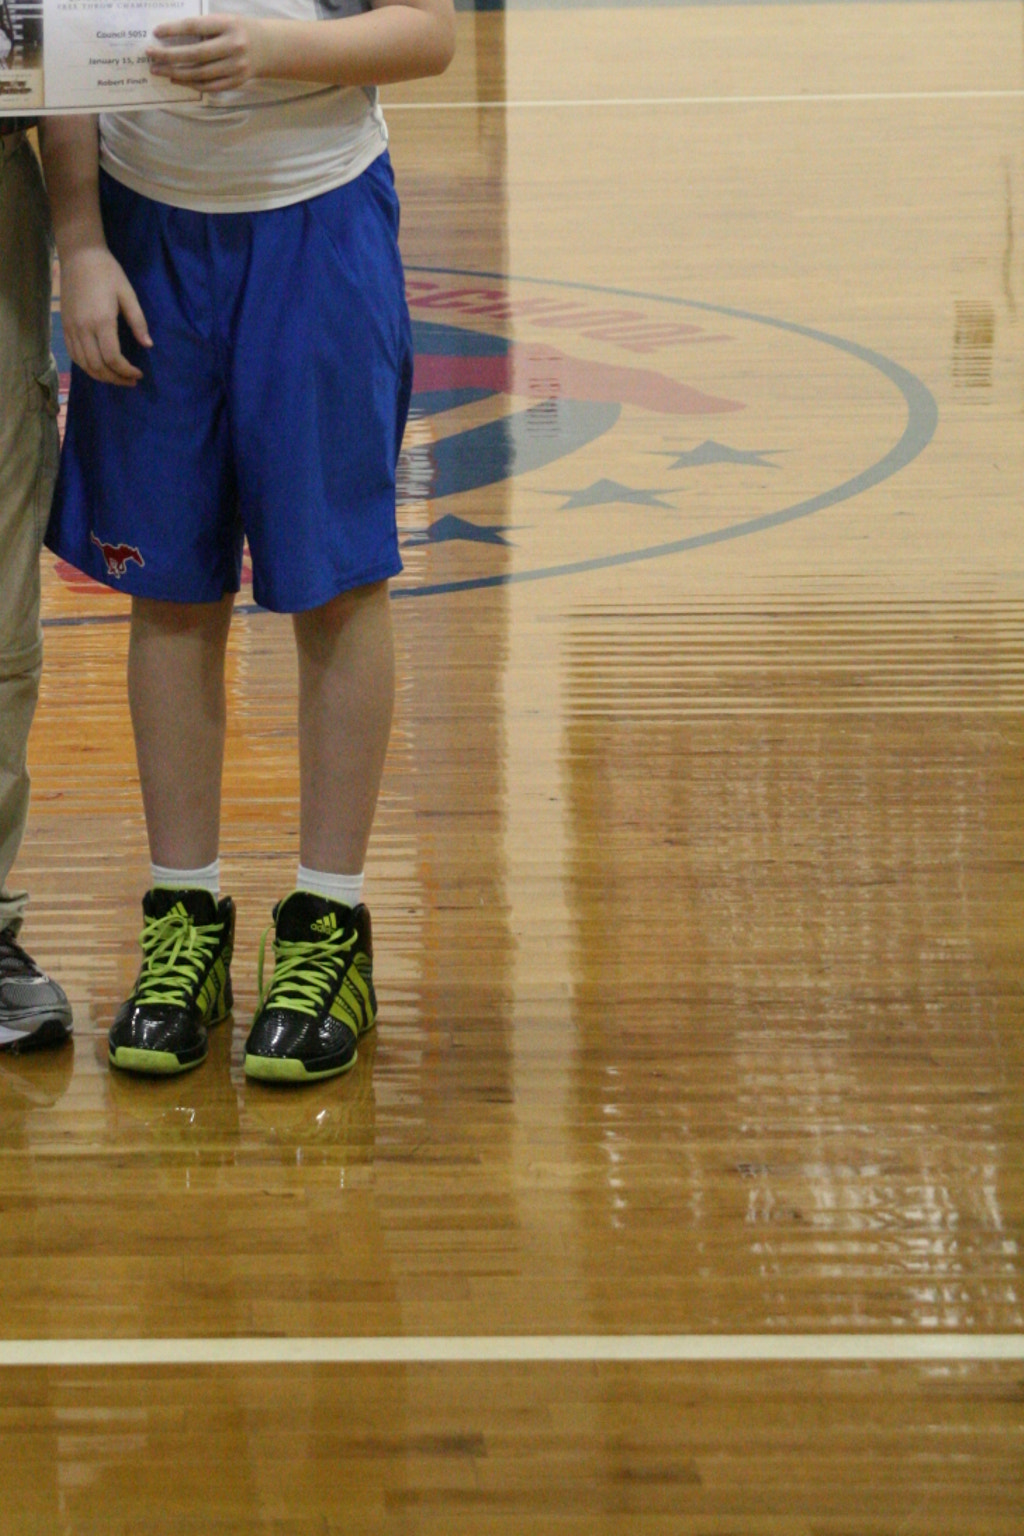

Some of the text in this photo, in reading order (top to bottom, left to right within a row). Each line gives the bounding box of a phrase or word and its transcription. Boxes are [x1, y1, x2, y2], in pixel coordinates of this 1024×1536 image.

[96, 30, 126, 39] Council
[89, 57, 120, 66] January
[97, 79, 125, 87] Robert
